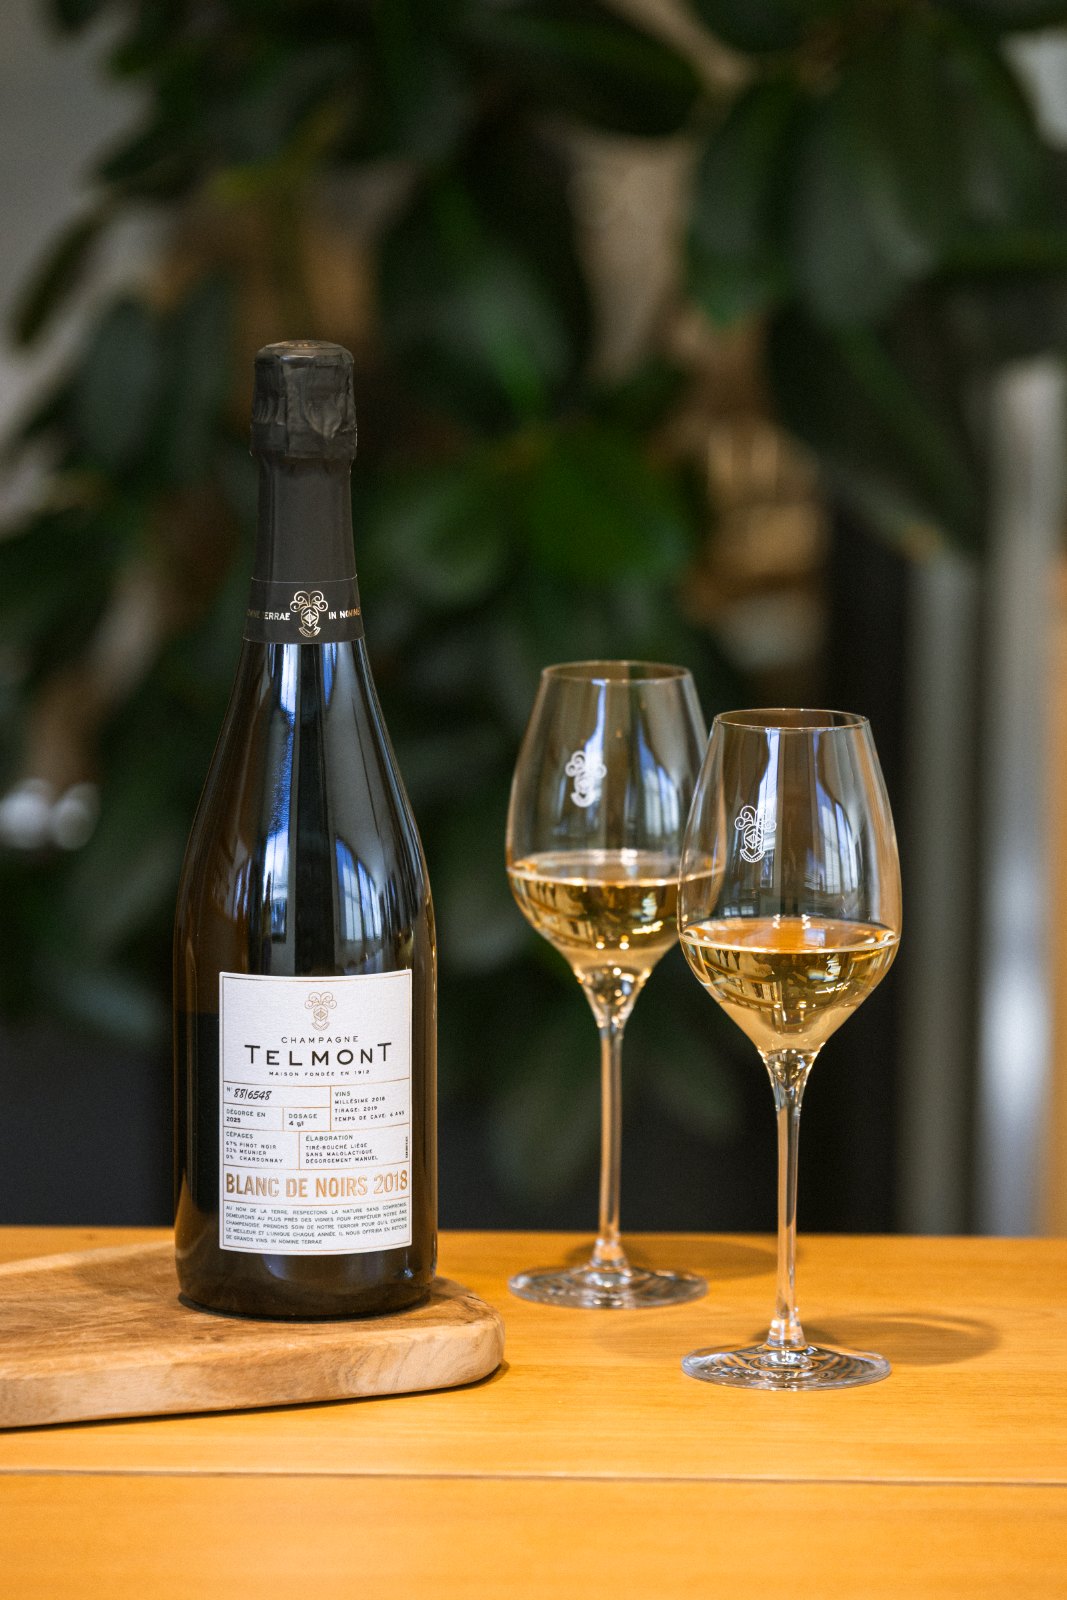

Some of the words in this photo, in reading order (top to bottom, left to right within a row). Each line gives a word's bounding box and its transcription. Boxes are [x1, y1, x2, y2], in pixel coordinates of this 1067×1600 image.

[261, 611, 290, 620] ERRAE
[328, 611, 336, 620] IN
[244, 1042, 392, 1066] TELMONT
[226, 1172, 279, 1197] BLANC
[286, 1178, 308, 1197] DE
[316, 1175, 367, 1197] NOIRS
[374, 1170, 408, 1194] 2018
